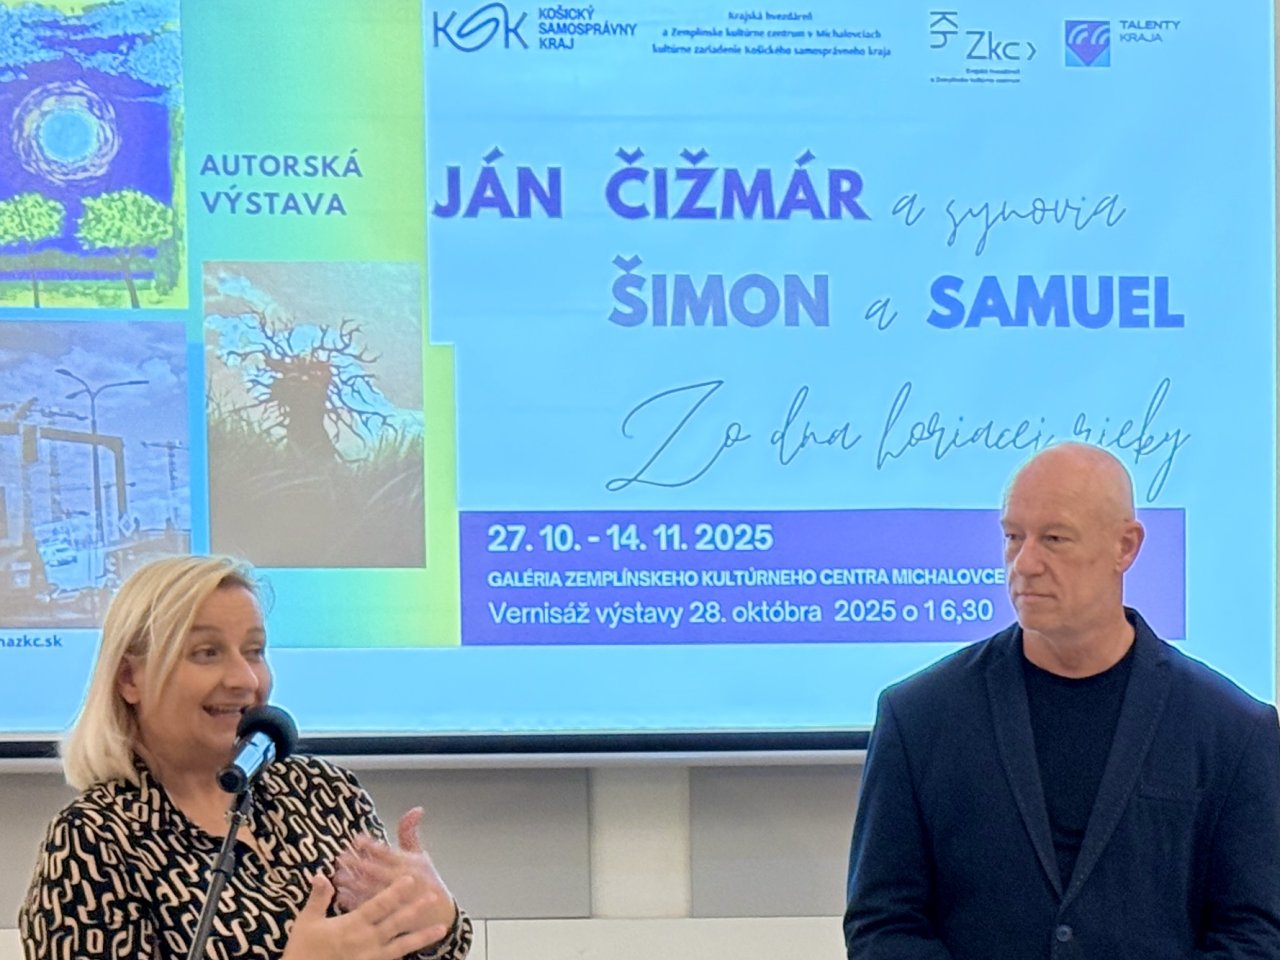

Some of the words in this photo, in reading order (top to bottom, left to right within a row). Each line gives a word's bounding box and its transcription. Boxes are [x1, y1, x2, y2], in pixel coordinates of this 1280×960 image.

[538, 4, 595, 20] KOŠICKÝ
[538, 20, 638, 36] SAMOSPRÁVNY
[767, 30, 805, 38] centrum
[1119, 20, 1181, 30] TALENTY
[1119, 32, 1163, 42] KRAJA
[539, 37, 575, 50] KRAJ
[200, 148, 363, 178] AUTORSKÁ
[200, 183, 348, 216] VÝSTAVA
[431, 146, 562, 219] JÁN
[605, 146, 872, 220] ČIŽMÁR
[892, 193, 925, 226] a
[946, 194, 1127, 257] synovia
[608, 254, 830, 328] ŠIMON
[864, 298, 898, 331] a
[926, 274, 1186, 330] SAMUEL
[605, 379, 751, 491] Zo
[769, 385, 863, 466] dna
[487, 524, 534, 552] 27.
[538, 524, 582, 551] 10.
[605, 524, 647, 551] 14.
[652, 524, 688, 550] 11.
[694, 523, 774, 551] 2025
[487, 568, 562, 587] GALÉRIA
[564, 567, 699, 587] ZEMPLÍNSKEHO
[701, 566, 817, 586] KULTÚRNEHO
[819, 568, 890, 585] CENTRA
[892, 568, 1005, 585] MICHALOVCE
[488, 600, 590, 625] Vernisáž
[595, 600, 683, 629] výstavy
[688, 601, 727, 624] 28.
[732, 600, 822, 623] októbra
[833, 600, 897, 622] 2025
[902, 605, 918, 622] o
